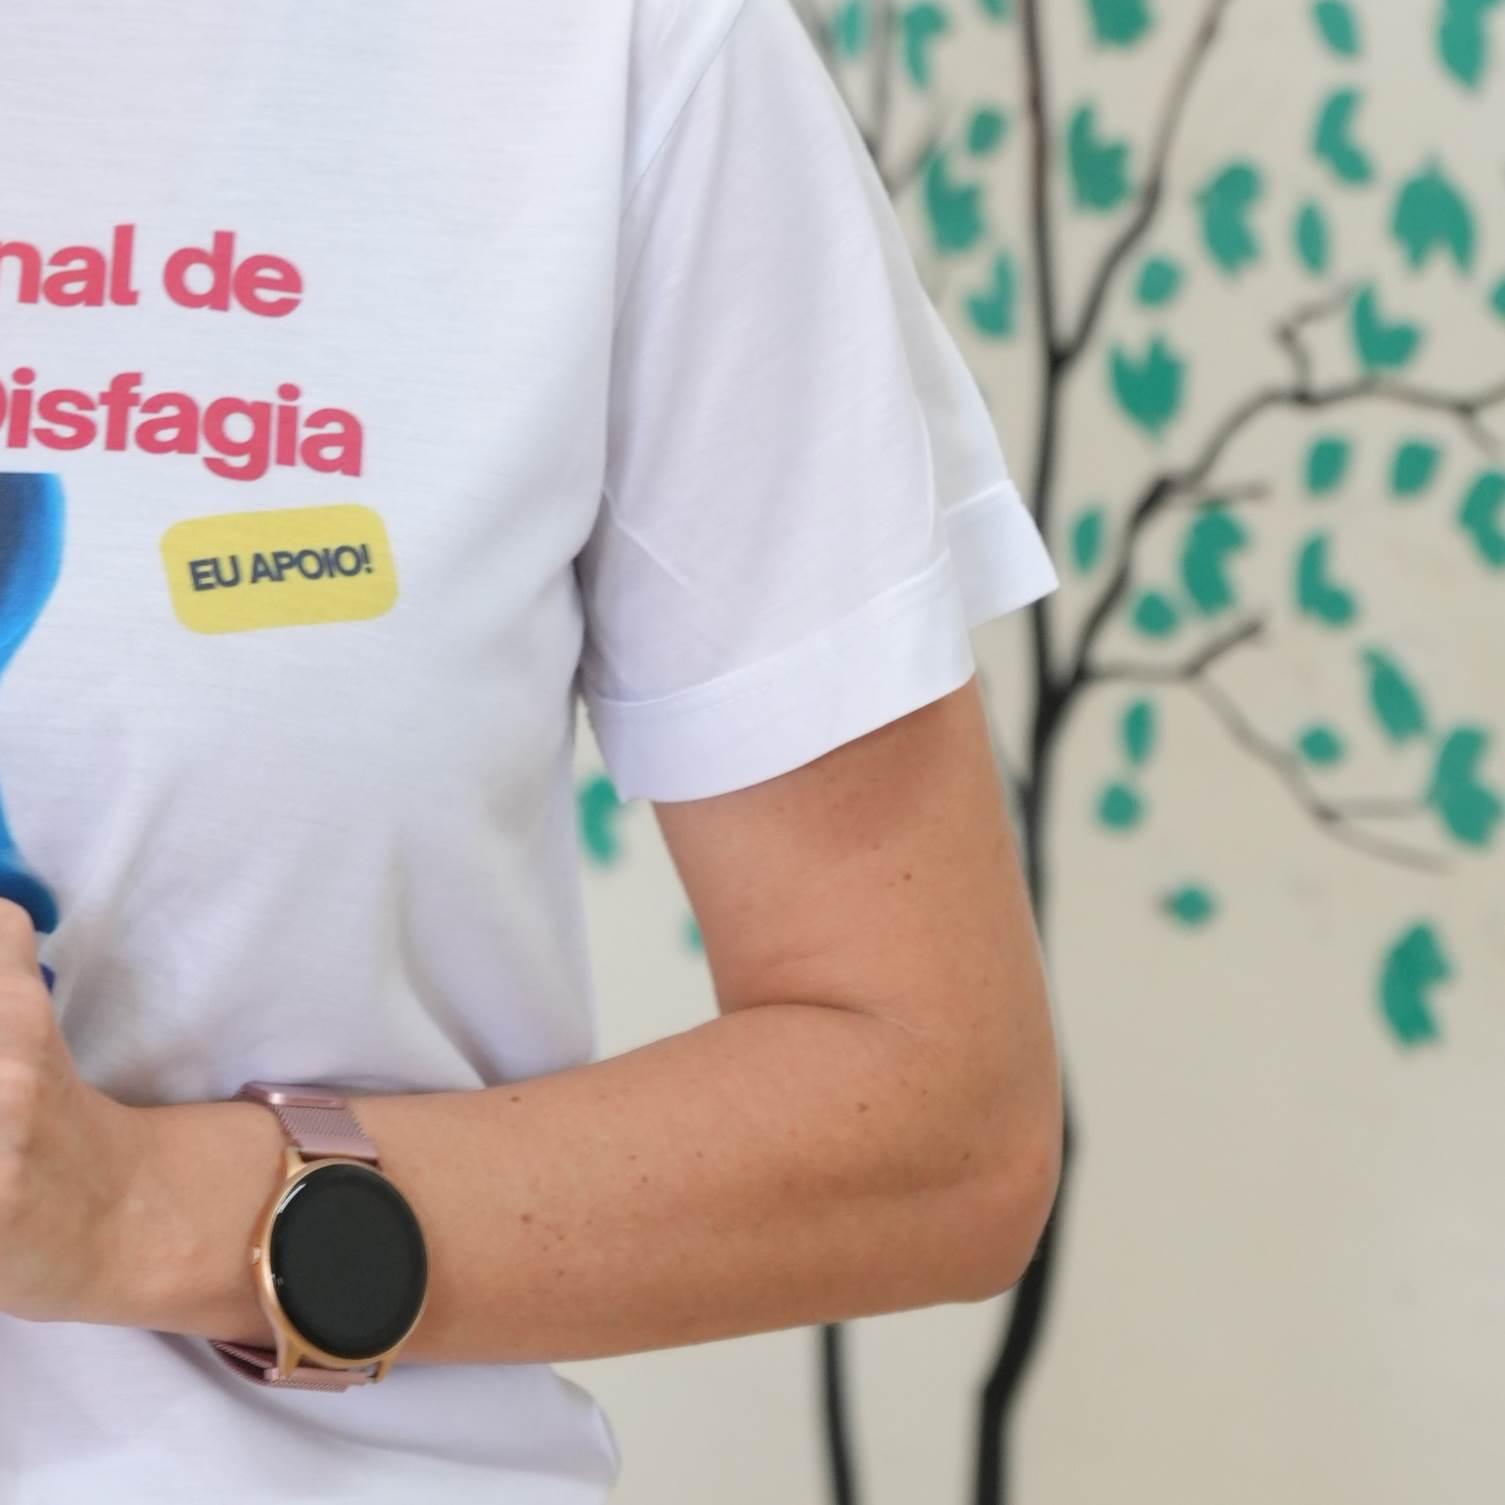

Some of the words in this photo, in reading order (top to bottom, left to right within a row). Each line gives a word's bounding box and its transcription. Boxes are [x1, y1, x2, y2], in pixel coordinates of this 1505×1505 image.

[162, 230, 304, 318] de
[188, 554, 242, 592] EU
[249, 542, 375, 584] APOIO!
